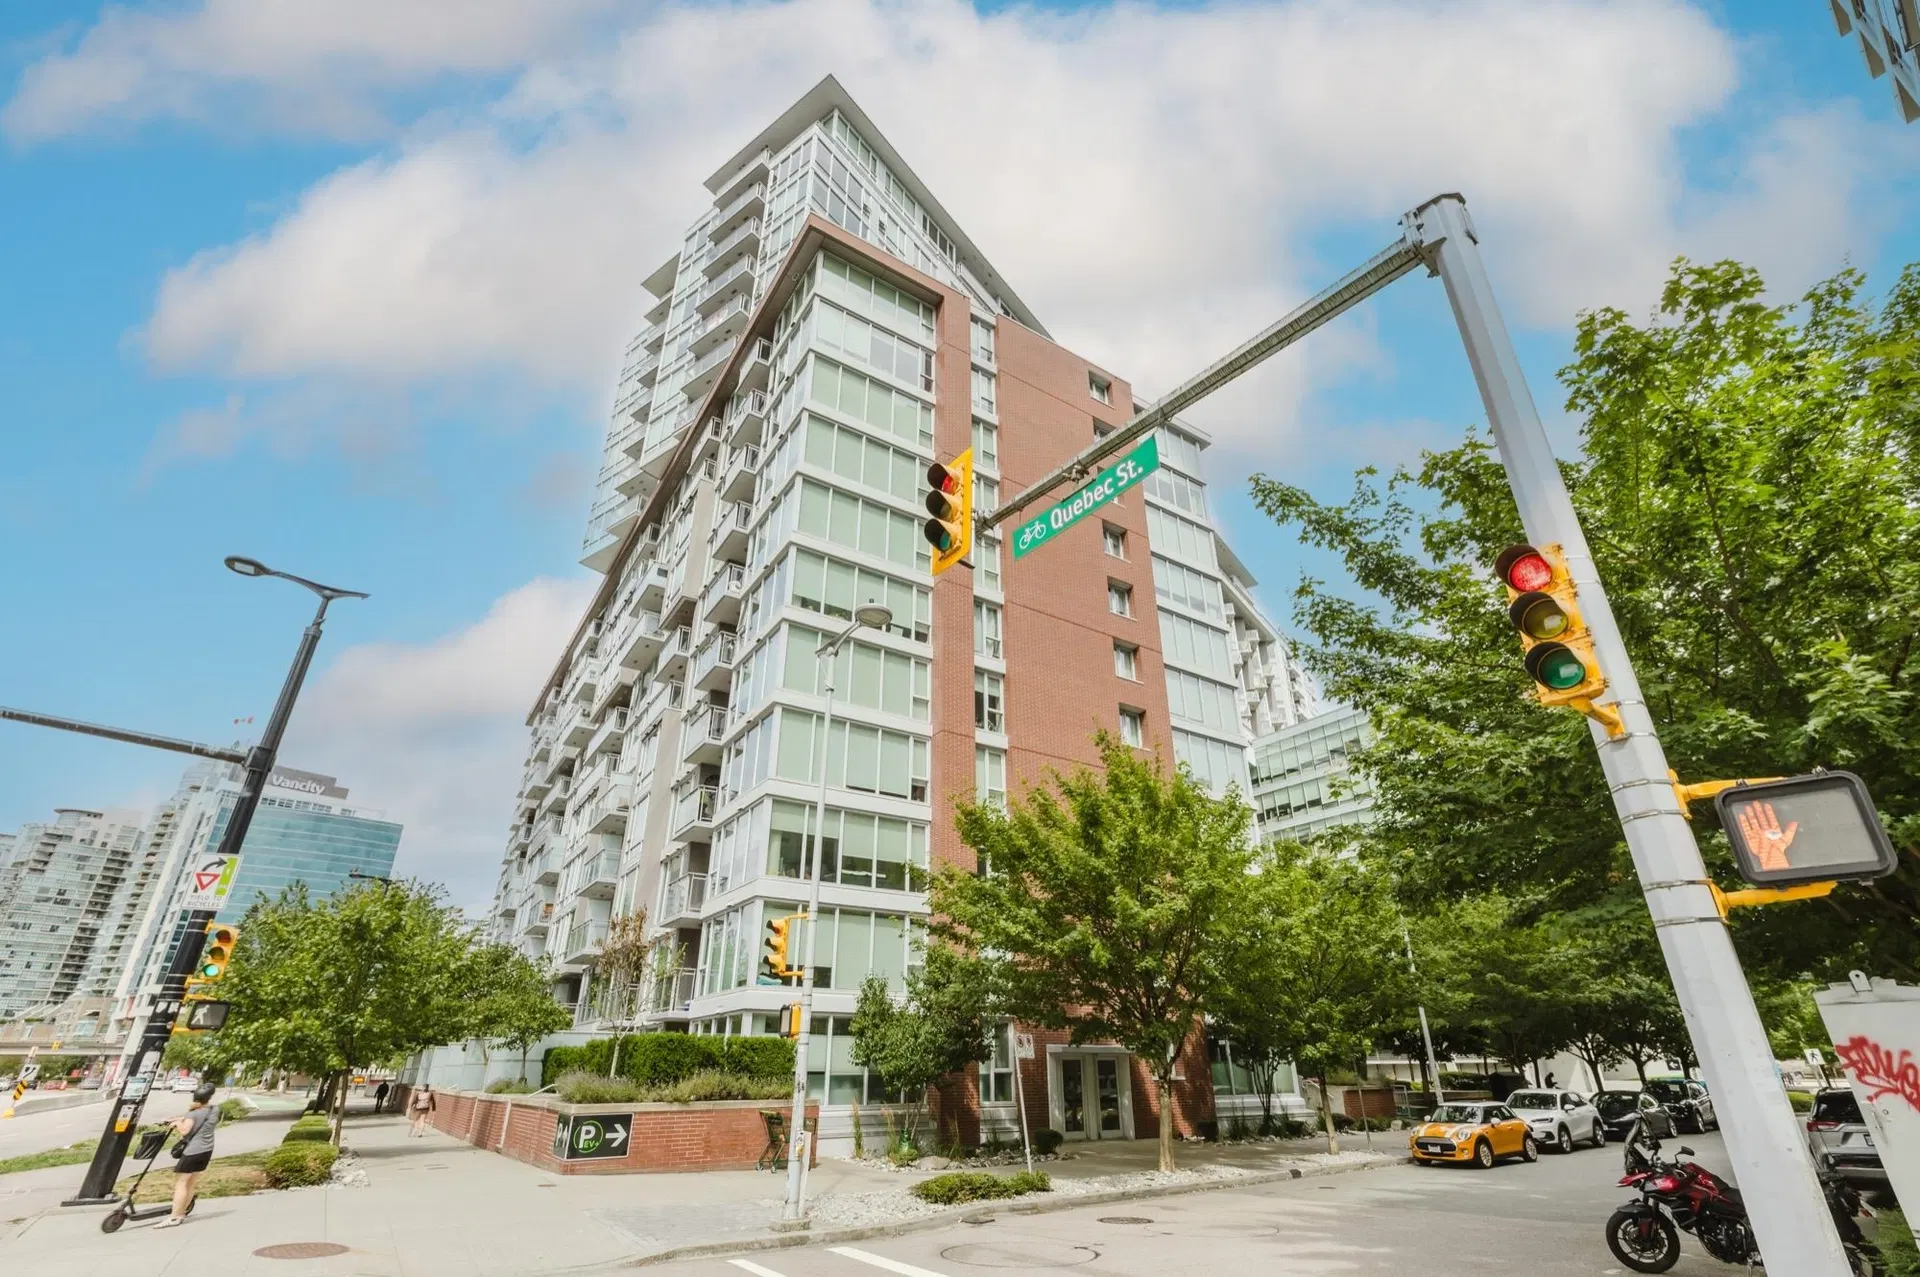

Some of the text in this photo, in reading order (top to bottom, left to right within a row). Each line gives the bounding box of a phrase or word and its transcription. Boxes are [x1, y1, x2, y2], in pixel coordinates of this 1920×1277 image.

[1050, 459, 1144, 530] Quebec St.
[272, 773, 326, 795] Vancity
[579, 1125, 596, 1149] P
